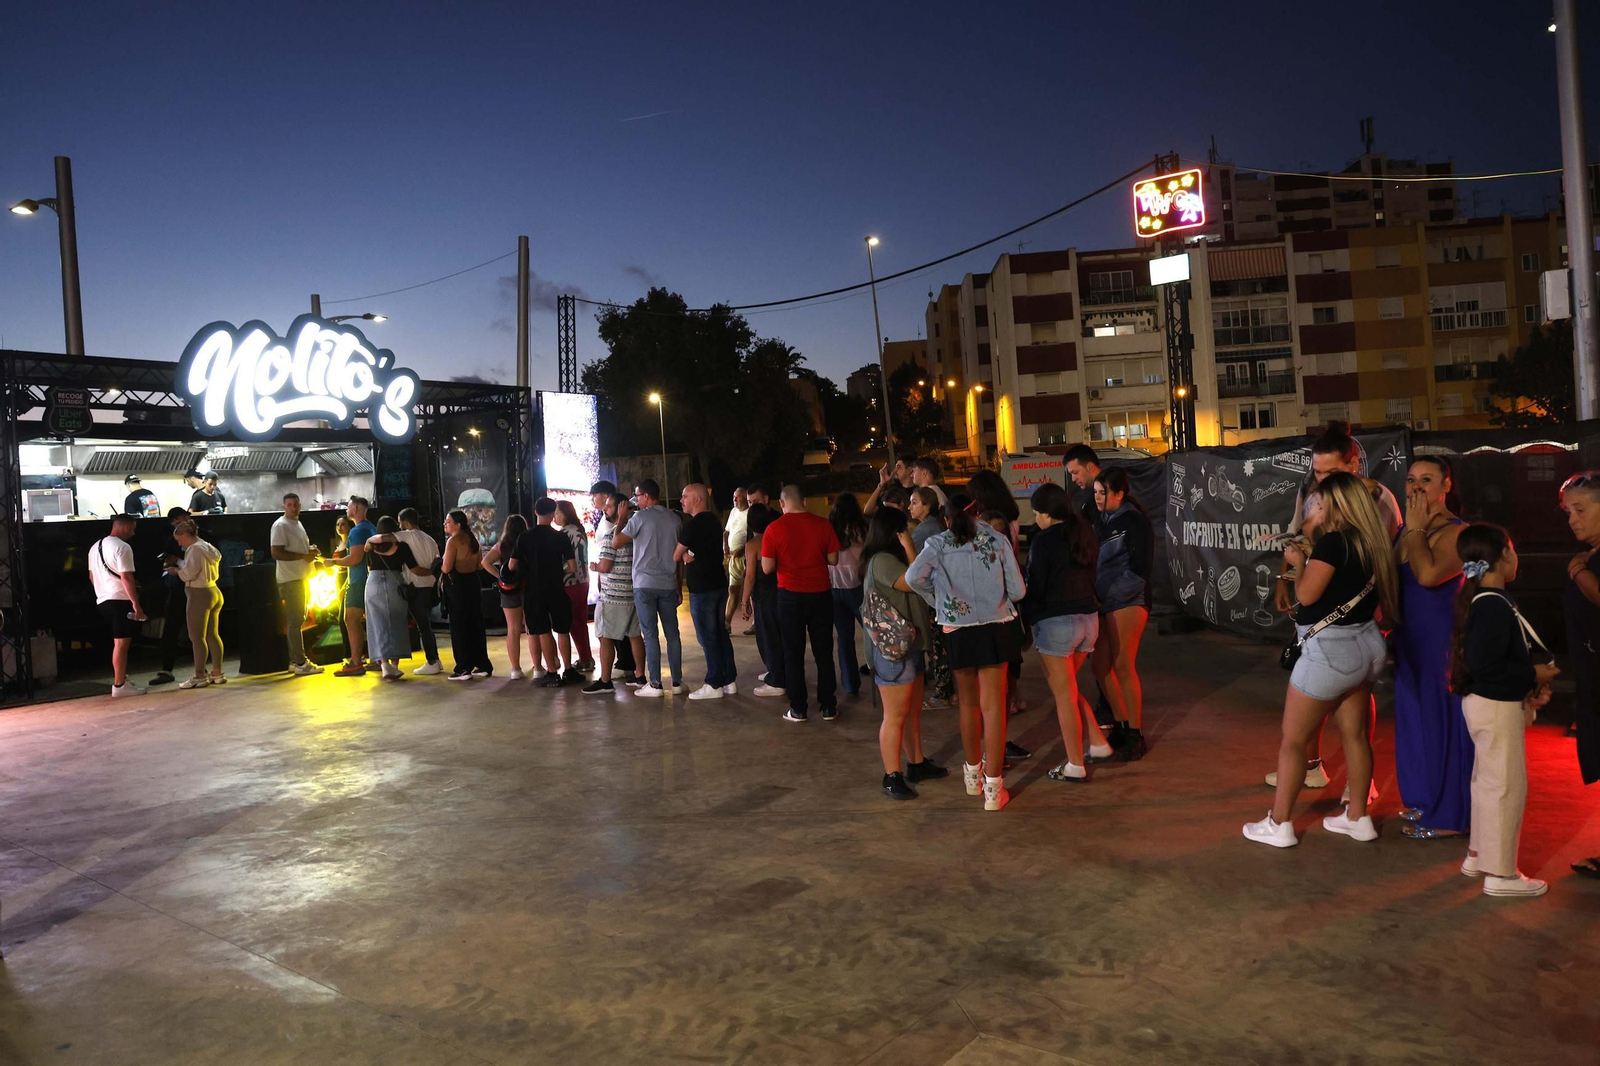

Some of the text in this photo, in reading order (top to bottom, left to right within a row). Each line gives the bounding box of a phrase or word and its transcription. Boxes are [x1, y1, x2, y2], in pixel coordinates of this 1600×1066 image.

[188, 322, 415, 437] Nolito's
[58, 392, 83, 400] RECOGE
[59, 408, 82, 418] Uber
[59, 418, 82, 428] Eats
[462, 458, 486, 473] AZUL
[1012, 461, 1063, 471] AMBULANCIA
[1300, 454, 1311, 467] 66
[384, 472, 409, 483] NEXT
[386, 486, 411, 498] LEVEL
[1225, 523, 1241, 550] EN
[1242, 523, 1283, 552] CADA
